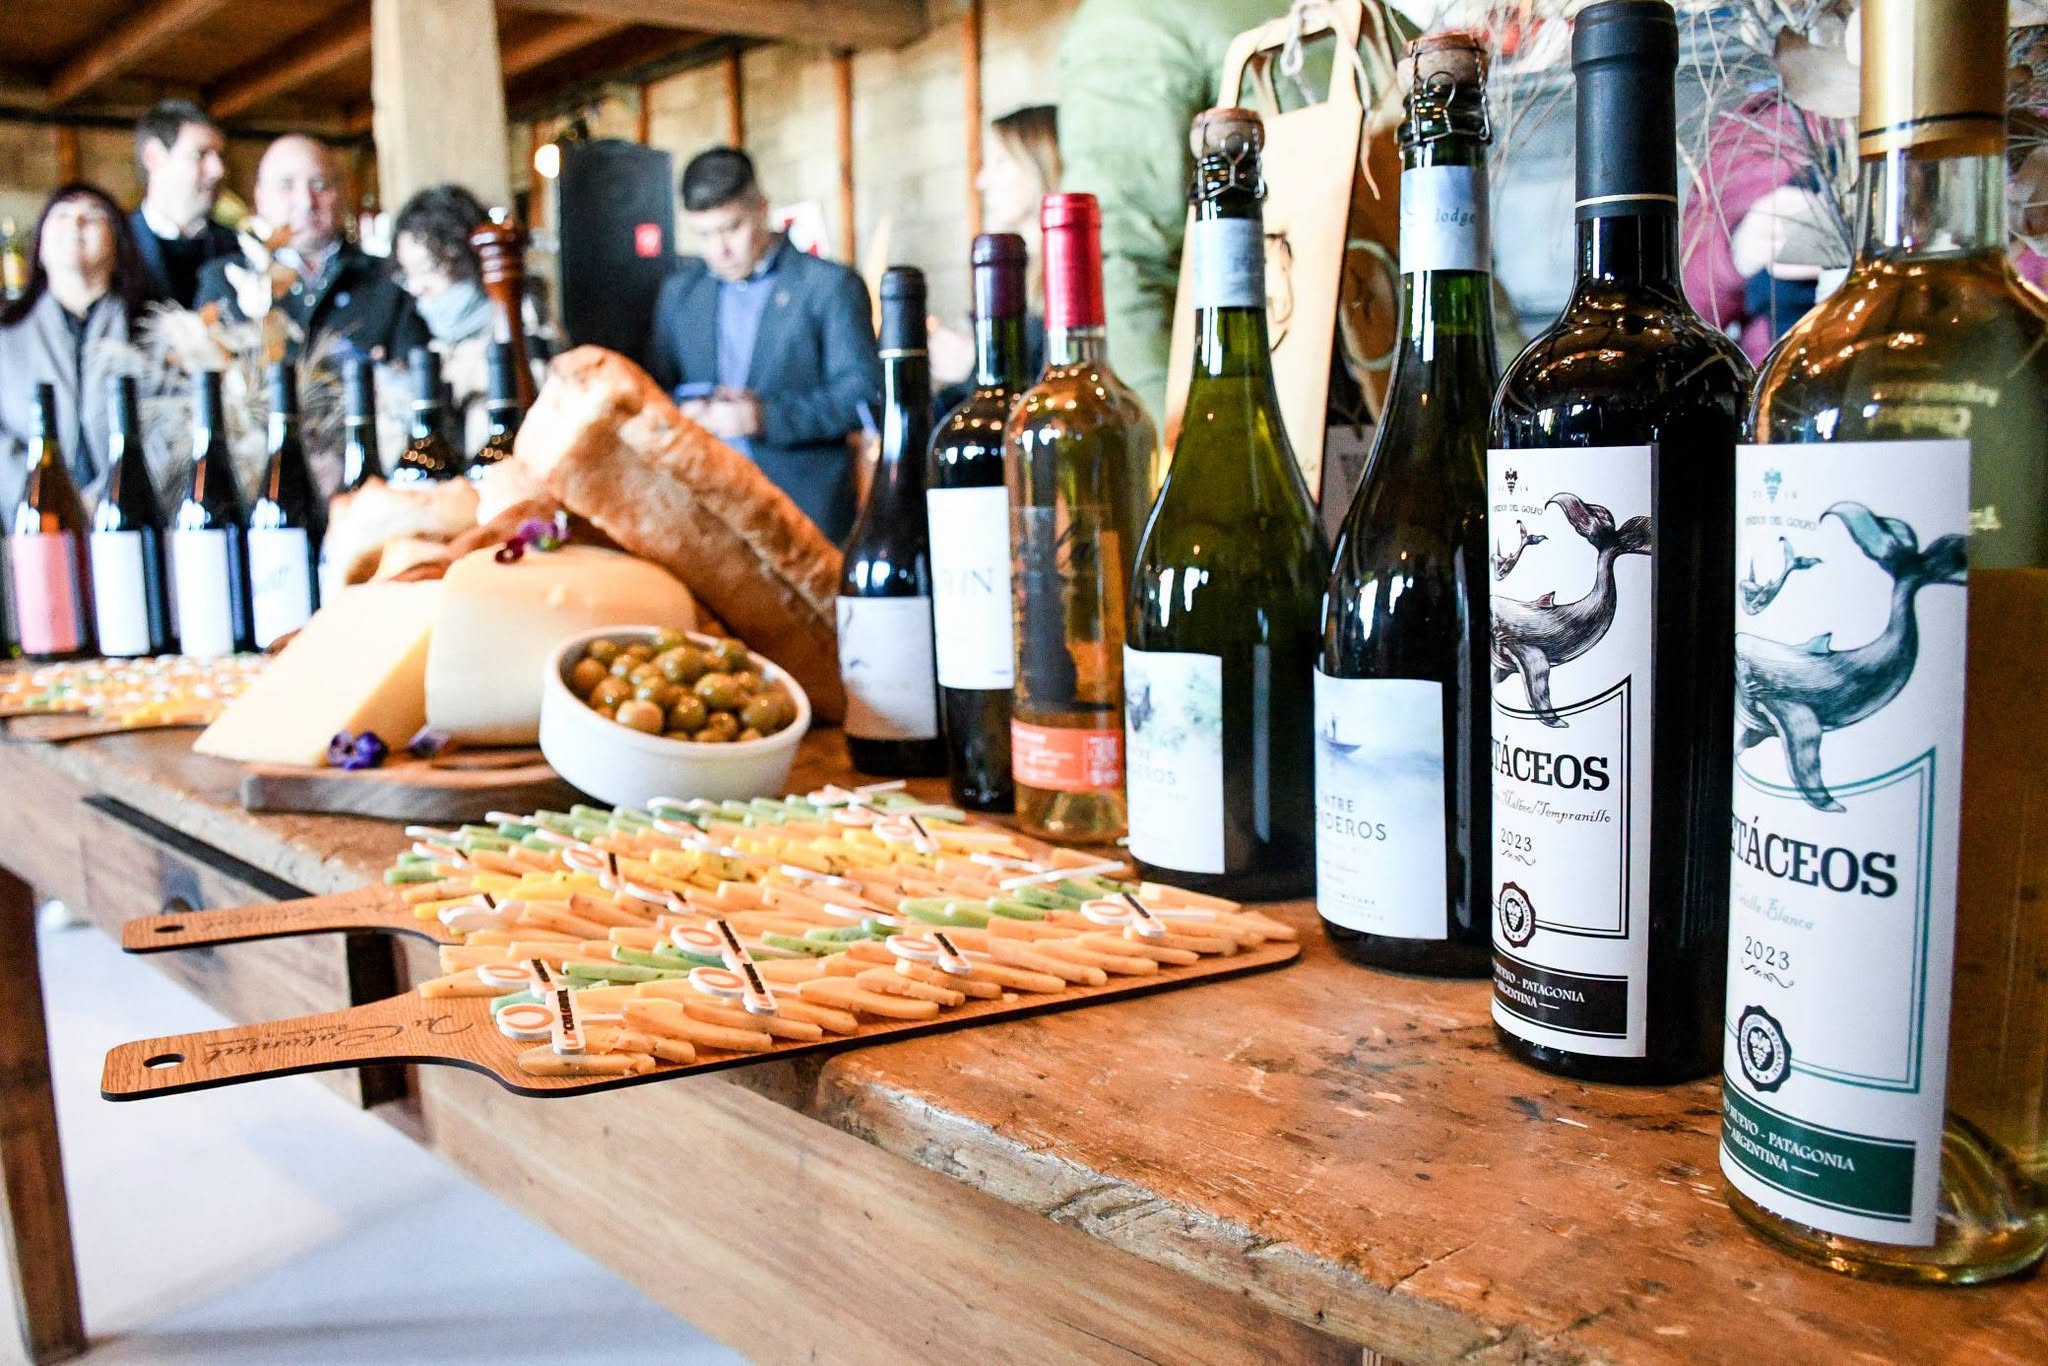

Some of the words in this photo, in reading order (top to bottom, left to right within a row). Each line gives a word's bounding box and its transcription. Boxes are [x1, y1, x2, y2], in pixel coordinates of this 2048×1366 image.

[1500, 828, 1533, 852] 2023
[1744, 935, 1791, 971] 2023
[1522, 978, 1585, 1003] PATAGONIA
[1730, 1105, 1759, 1136] NUEVO
[1768, 1131, 1856, 1172] PATAGONIA
[1730, 1127, 1789, 1173] ARGENTINA
